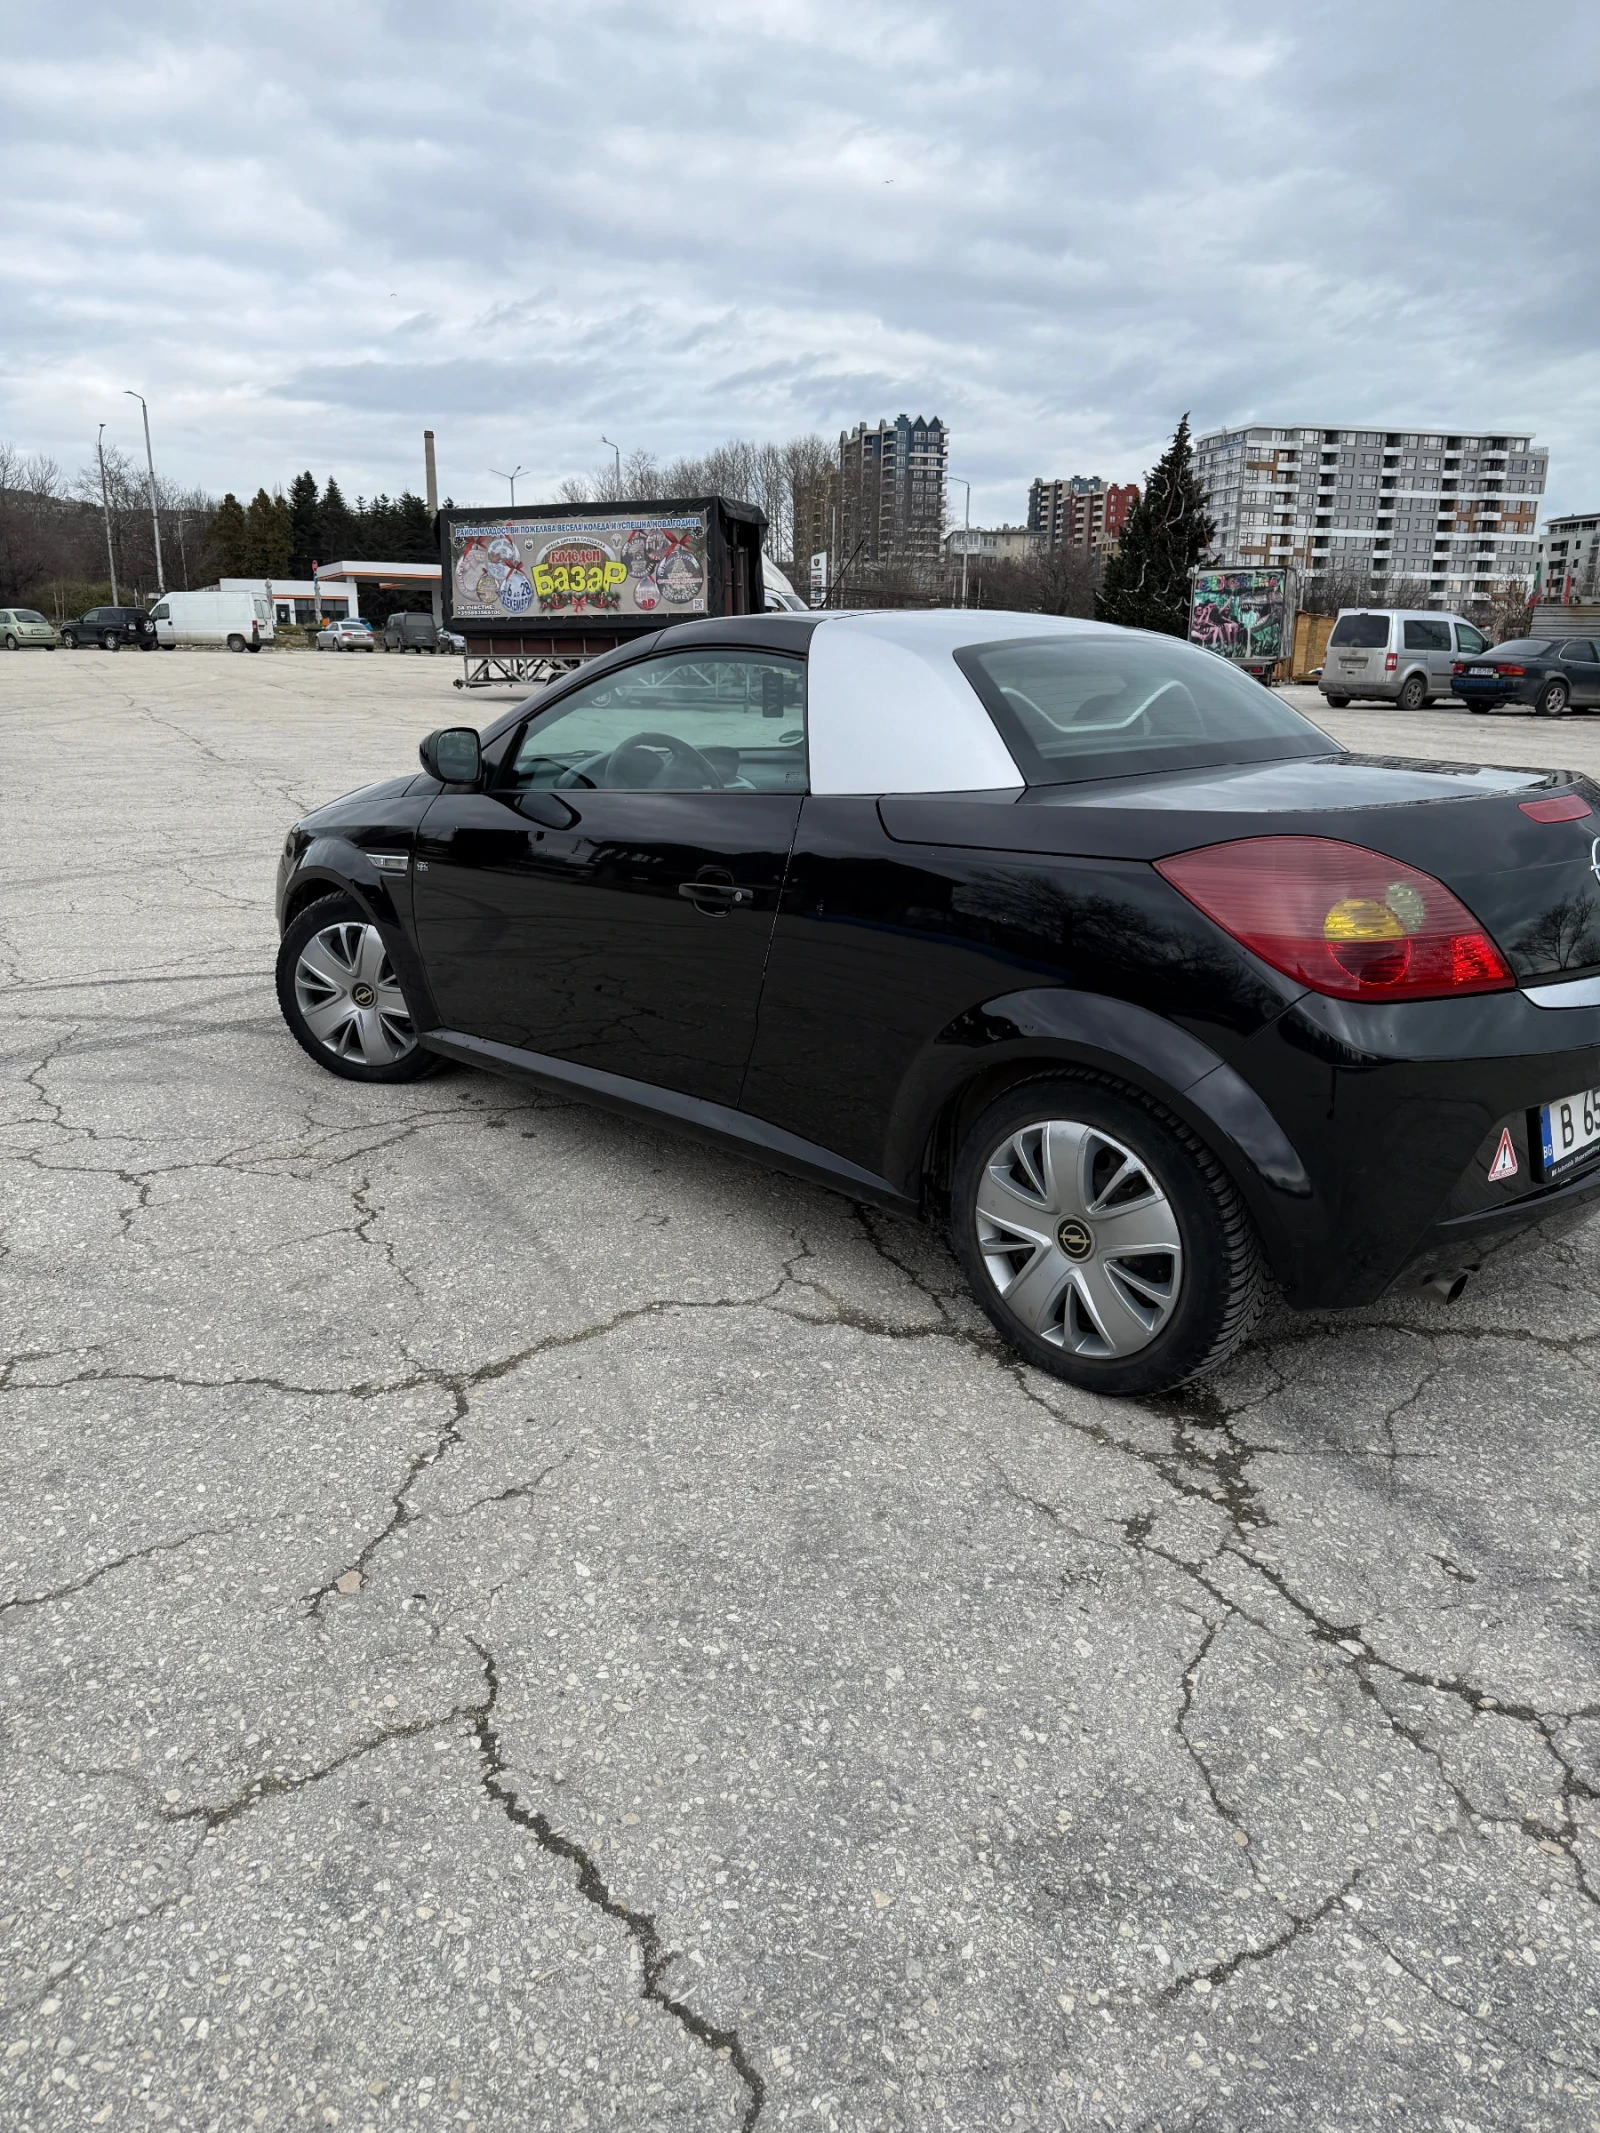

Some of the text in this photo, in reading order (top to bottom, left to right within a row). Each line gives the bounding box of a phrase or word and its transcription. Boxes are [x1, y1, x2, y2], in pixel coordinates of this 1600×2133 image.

[455, 517, 701, 537] РАЙОН МЛАДОСТ ВИ ПОЖЕЛАВА ВЕСЕЛА КОЛЕДА И УСПЕШНА НОВА ГОДИНА
[551, 550, 600, 563] КОЛЕДЕН
[507, 583, 513, 597] 6
[520, 582, 531, 597] 28
[1560, 1103, 1574, 1150] B
[1543, 1144, 1553, 1160] BG
